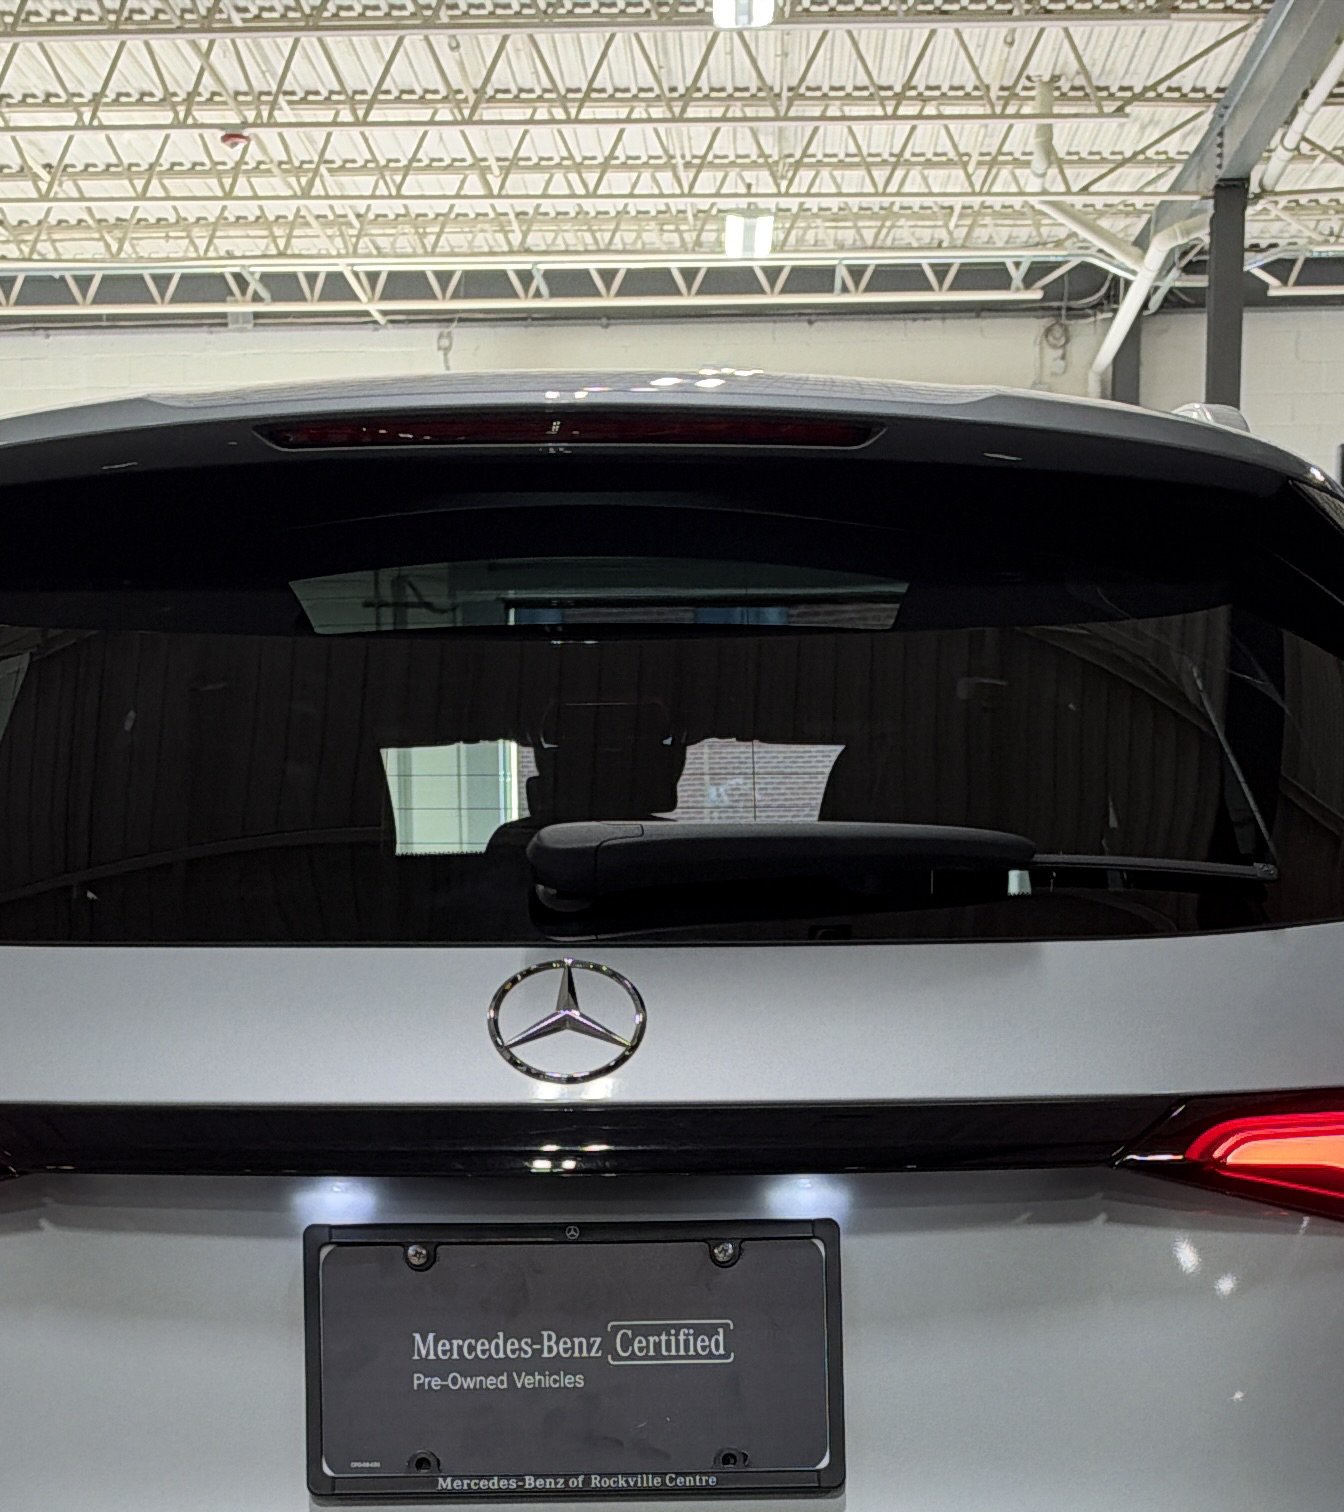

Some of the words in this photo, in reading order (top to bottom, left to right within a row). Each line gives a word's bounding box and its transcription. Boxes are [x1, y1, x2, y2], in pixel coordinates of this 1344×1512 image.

[411, 1330, 603, 1360] Mercedes-Benz
[615, 1327, 726, 1358] Certified
[412, 1371, 507, 1391] Pre-Owned
[512, 1370, 585, 1389] Vehicles
[436, 1475, 565, 1490] Mercedes-Benz
[568, 1474, 586, 1488] of
[590, 1474, 662, 1488] Rockville
[665, 1473, 717, 1487] Centre
